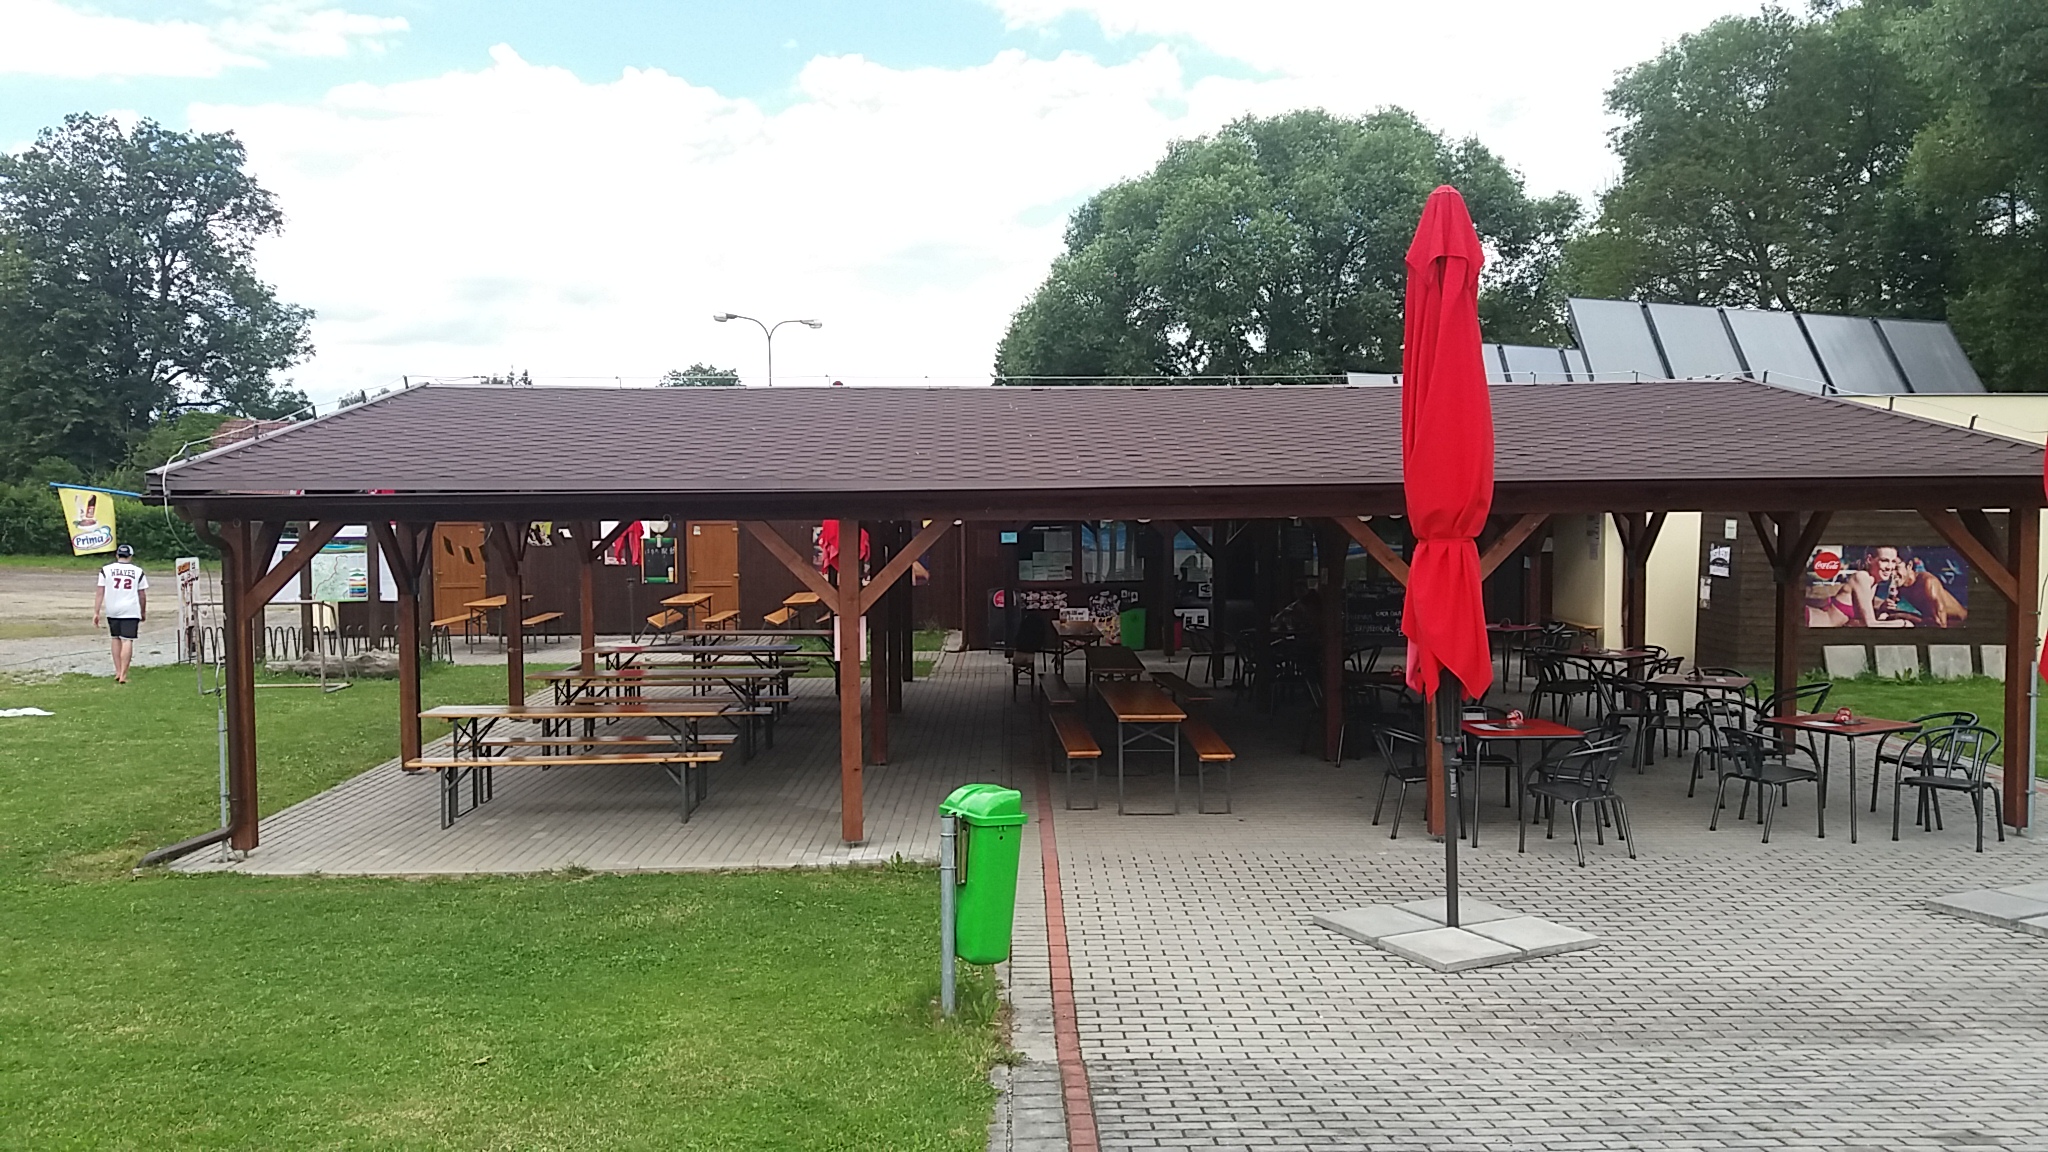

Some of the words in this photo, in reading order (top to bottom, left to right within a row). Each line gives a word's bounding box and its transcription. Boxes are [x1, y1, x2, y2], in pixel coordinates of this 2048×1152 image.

[76, 536, 104, 546] Prima
[110, 569, 136, 580] WEAVER
[113, 578, 132, 590] 72
